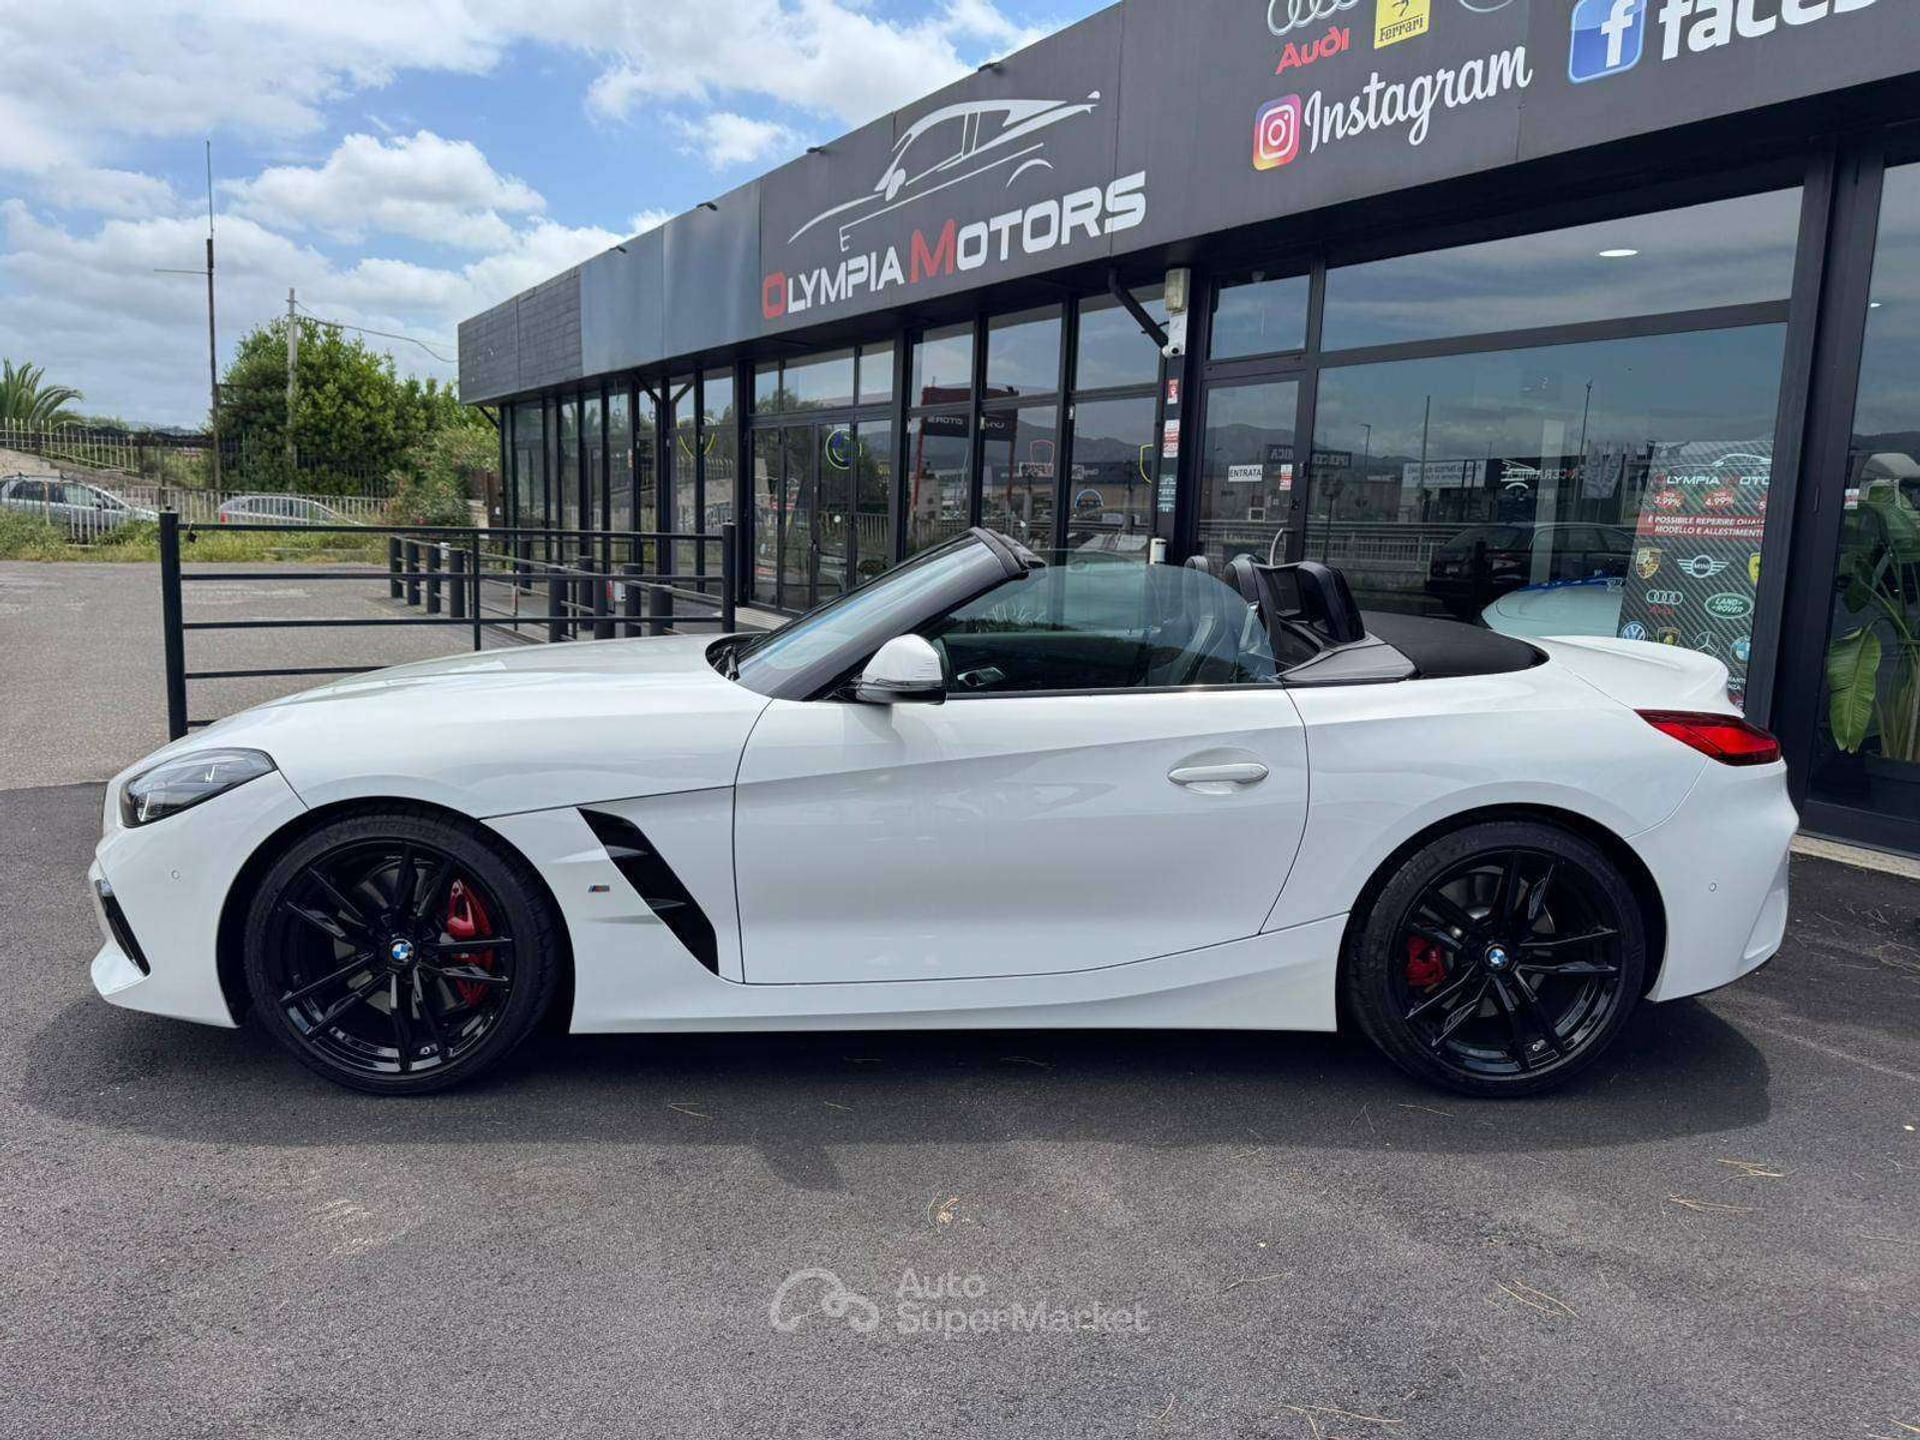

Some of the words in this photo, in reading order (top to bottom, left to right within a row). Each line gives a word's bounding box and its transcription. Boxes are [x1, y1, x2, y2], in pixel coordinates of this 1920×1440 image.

[1378, 14, 1424, 42] Ferrari
[1275, 26, 1350, 75] Audi
[1304, 46, 1533, 154] Instagram
[762, 246, 906, 320] OLYMPIA
[910, 170, 1147, 284] MOTORS
[1229, 468, 1262, 478] ENTRATA
[1655, 516, 1693, 525] POSSIBILE
[1696, 517, 1734, 525] REPERIRE
[1655, 525, 1694, 534] MODELLO
